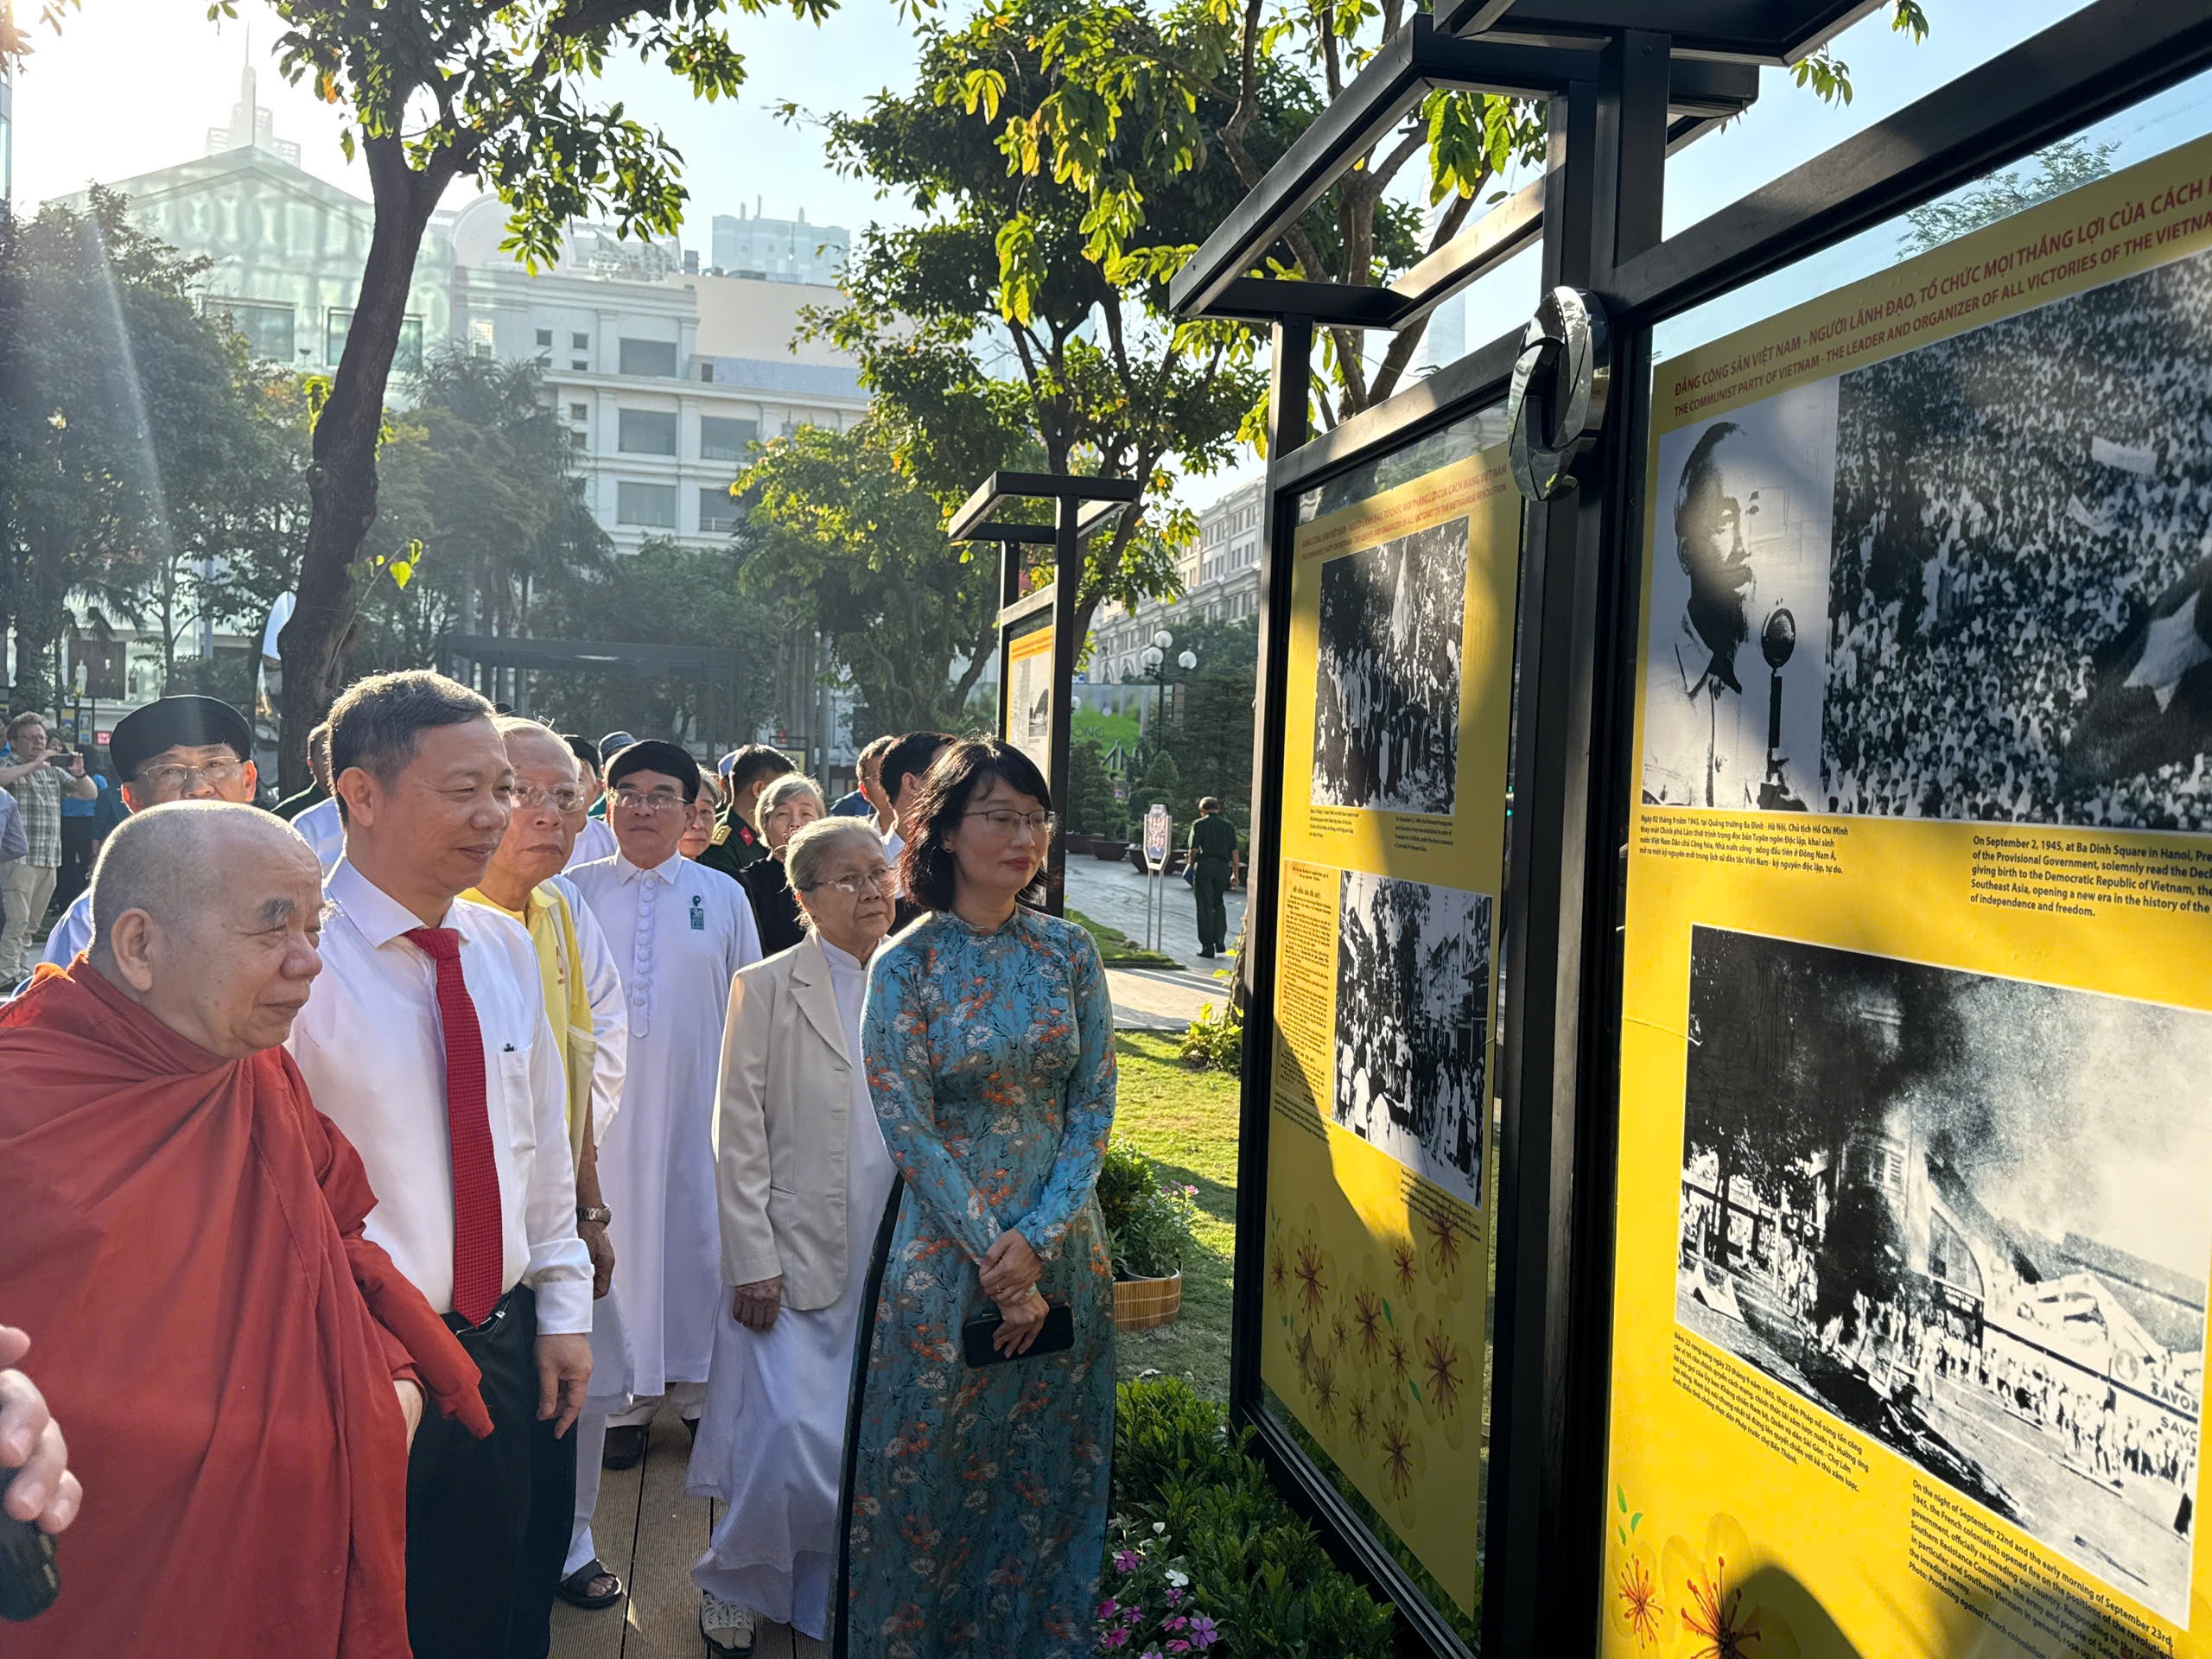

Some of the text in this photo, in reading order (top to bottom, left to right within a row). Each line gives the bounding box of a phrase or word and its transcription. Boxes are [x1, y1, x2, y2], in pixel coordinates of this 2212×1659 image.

[1675, 375, 1700, 396] ĐẢNG
[1702, 365, 1728, 386] CỘNG
[1731, 355, 1749, 375] SẢN
[1752, 346, 1773, 366] VIỆT
[1777, 336, 1801, 357] NAM
[1809, 317, 1847, 345] NGƯỜI
[1885, 293, 1916, 317] ĐẠO,
[1941, 266, 1980, 295] CHỨC
[1984, 253, 2013, 278] MỌI
[2077, 217, 2104, 244] LỢI
[2108, 202, 2145, 231] CỦA
[2151, 180, 2202, 214] CÁCH
[1675, 403, 1688, 416] THE
[1689, 385, 1738, 411] COMMUNIST
[1738, 375, 1764, 394] PARTY
[1765, 370, 1777, 385] OF
[1779, 355, 1819, 378] VIETNAM
[1826, 346, 1844, 362] THE
[1847, 332, 1885, 355] LEADER
[1887, 322, 1910, 341] AND
[1913, 297, 1979, 331] ORGANIZER
[1981, 289, 1999, 307] OF
[2001, 281, 2024, 301] ALL
[2027, 253, 2097, 289] VICTORIES
[2101, 245, 2120, 264] OF
[2123, 233, 2152, 256] THE
[1821, 838, 1834, 847] sinh
[1832, 826, 1848, 836] Minh
[1815, 850, 1829, 860] Nam
[1973, 849, 1981, 860] of
[1982, 850, 1995, 861] the
[1997, 852, 2041, 864] Provisional
[2043, 855, 2100, 870] Government,
[2101, 861, 2144, 874] solemnly
[2146, 865, 2169, 875] read
[2171, 865, 2188, 877] the
[1974, 836, 1985, 845] On
[1986, 836, 2030, 849] September
[2031, 839, 2038, 850] 2,
[2041, 840, 2063, 852] 1945,
[2065, 842, 2075, 852] at
[2076, 842, 2088, 853] Ba
[2090, 843, 2111, 855] Dinh
[2113, 845, 2147, 858] Square
[2149, 847, 2158, 858] in
[2160, 849, 2193, 861] Hanoi,
[1971, 879, 2010, 892] Southeast
[2012, 882, 2031, 894] Asia,
[2032, 887, 2068, 900] opening
[2076, 892, 2095, 901] new
[2097, 893, 2112, 903] era
[2113, 893, 2123, 904] in
[2126, 894, 2140, 906] the
[2143, 896, 2177, 912] history
[2179, 900, 2191, 912] of
[2193, 901, 2210, 913] the
[1972, 865, 1996, 878] giving
[1997, 866, 2018, 877] birth
[2019, 869, 2027, 879] to
[2029, 869, 2044, 880] the
[2044, 871, 2094, 885] Democratic
[2096, 875, 2136, 889] Republic
[2139, 879, 2149, 890] of
[2150, 880, 2195, 895] Vietnam,
[1970, 893, 2095, 916] of independence and freedom.
[1909, 1548, 1919, 1560] the
[1920, 1555, 1947, 1581] invading
[1913, 1479, 1922, 1491] On
[1923, 1485, 1933, 1498] the
[1934, 1494, 1950, 1509] night
[1952, 1505, 1960, 1514] of
[1960, 1508, 1995, 1535] September
[1996, 1530, 2014, 1548] 22nd
[2014, 1544, 2029, 1557] and
[2030, 1552, 2042, 1565] the
[2042, 1561, 2061, 1578] early
[2062, 1573, 2094, 1599] morning
[2095, 1594, 2105, 1605] of
[2105, 1598, 2150, 1631] September
[1913, 1493, 2126, 1634] 1945, the French colonialists opened fire on the positions of the
[1910, 1520, 2097, 1648] Southern Resistance Committee, the army and people of
[1911, 1509, 1950, 1538] government,
[1951, 1535, 1979, 1557] officially
[1979, 1552, 2018, 1583] re-invading
[2019, 1577, 2031, 1590] our
[2063, 1604, 2109, 1641] Responding
[2110, 1634, 2119, 1646] to
[1929, 1575, 1960, 1603] Protesting
[1950, 1562, 1962, 1575] and
[1963, 1569, 1993, 1594] Southern
[1994, 1590, 2023, 1611] Vietnam
[2024, 1609, 2031, 1621] in
